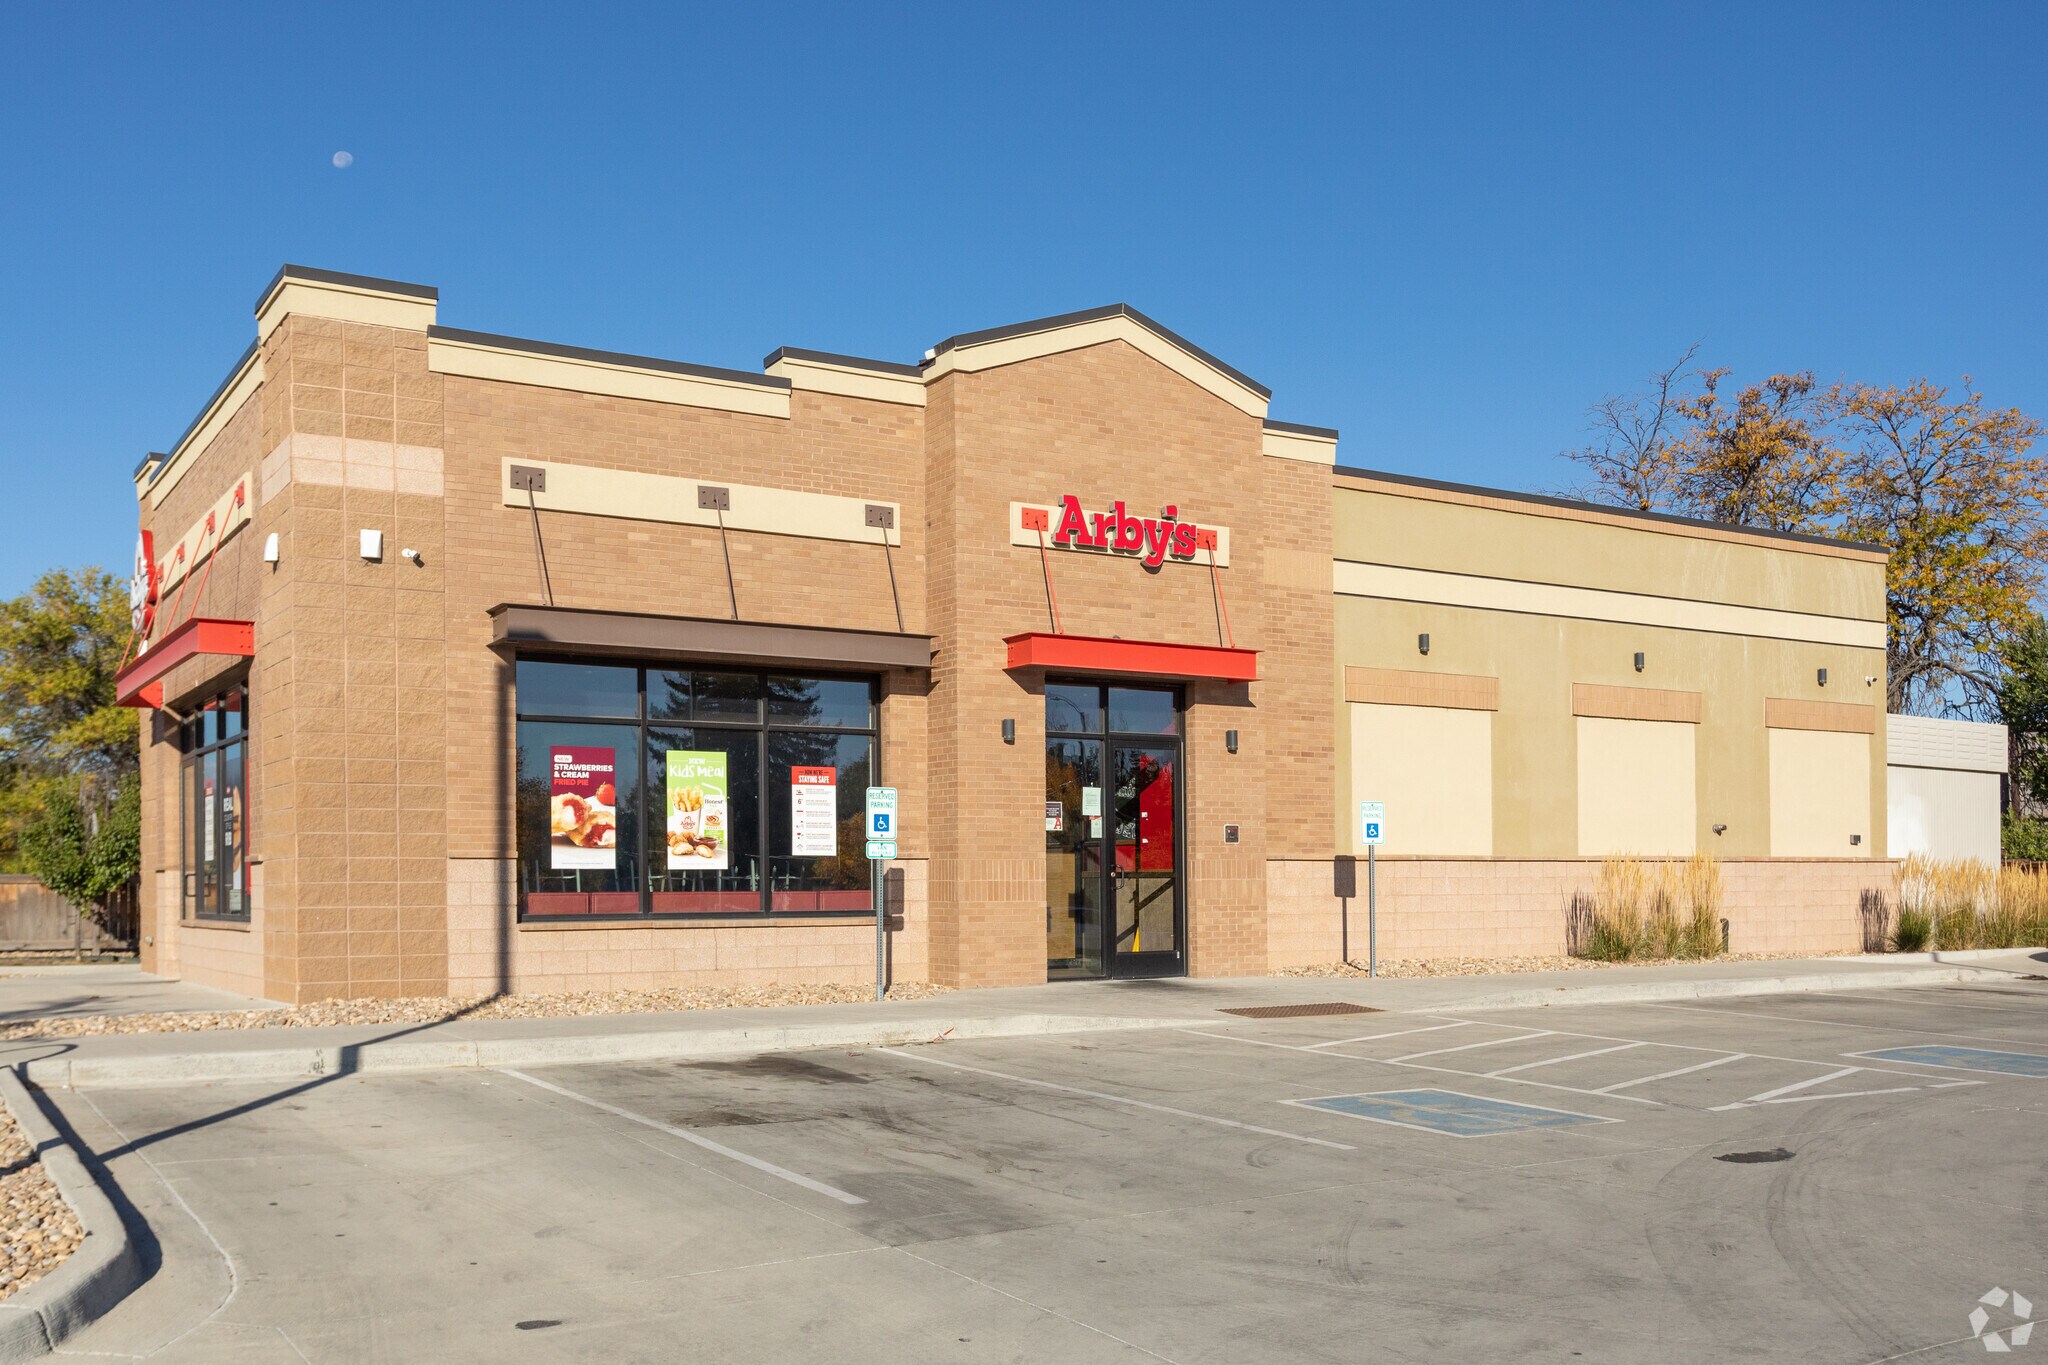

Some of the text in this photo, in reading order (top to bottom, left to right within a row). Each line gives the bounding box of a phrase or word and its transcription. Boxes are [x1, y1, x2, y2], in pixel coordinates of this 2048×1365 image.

[1052, 494, 1197, 571] Arby's
[554, 764, 613, 772] STRAWBERRIES
[554, 778, 576, 786] FRIED
[798, 775, 830, 784] STAYING SAFE
[869, 792, 895, 800] RESERVED
[871, 801, 893, 809] PARKING
